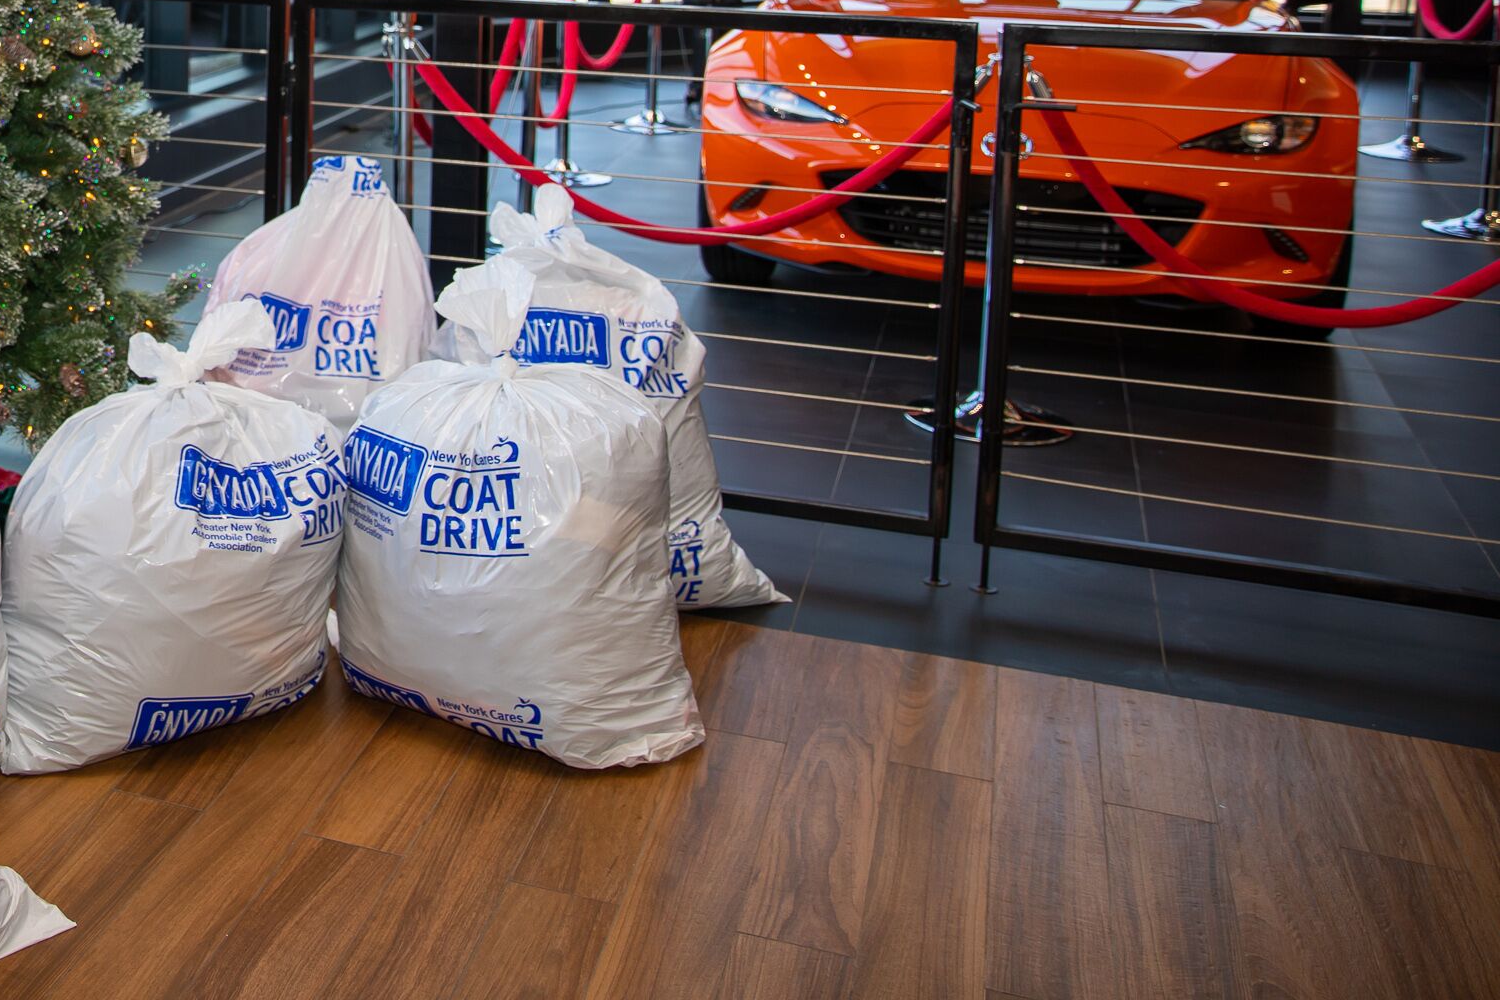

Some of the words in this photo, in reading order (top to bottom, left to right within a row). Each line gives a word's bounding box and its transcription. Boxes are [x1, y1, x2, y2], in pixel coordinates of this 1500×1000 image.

[317, 313, 377, 346] COA
[429, 450, 456, 464] New
[473, 453, 502, 467] Cares
[423, 472, 520, 515] COAT
[230, 523, 254, 533] New
[420, 512, 525, 550] DRIVE
[208, 541, 263, 554] Association
[436, 697, 462, 712] New
[462, 703, 489, 719] York
[489, 708, 524, 725] Cares
